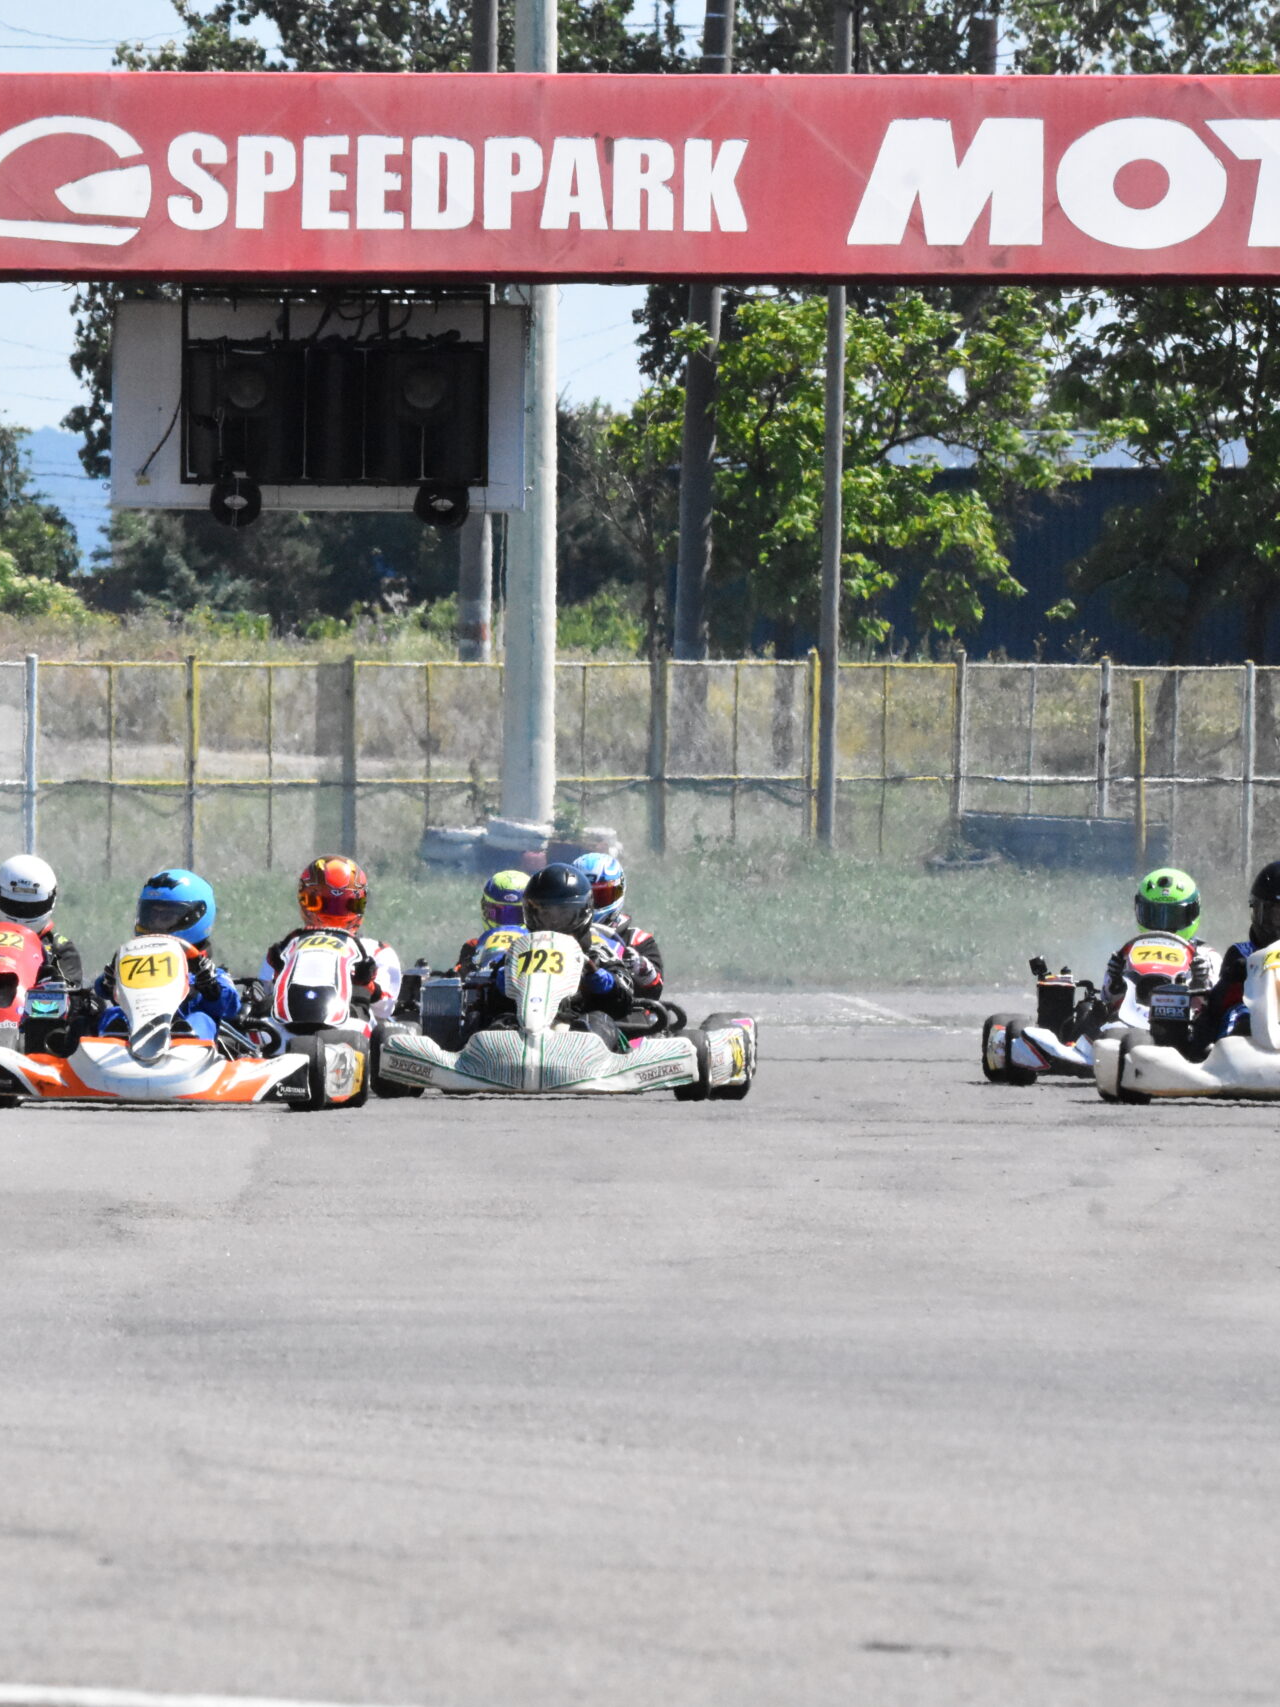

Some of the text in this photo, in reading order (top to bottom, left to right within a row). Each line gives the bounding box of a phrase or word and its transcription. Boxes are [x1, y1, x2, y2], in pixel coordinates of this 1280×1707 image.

[167, 131, 750, 233] SPEEDPARK
[121, 955, 173, 981] 741
[518, 949, 564, 974] 723
[1138, 950, 1180, 963] 716
